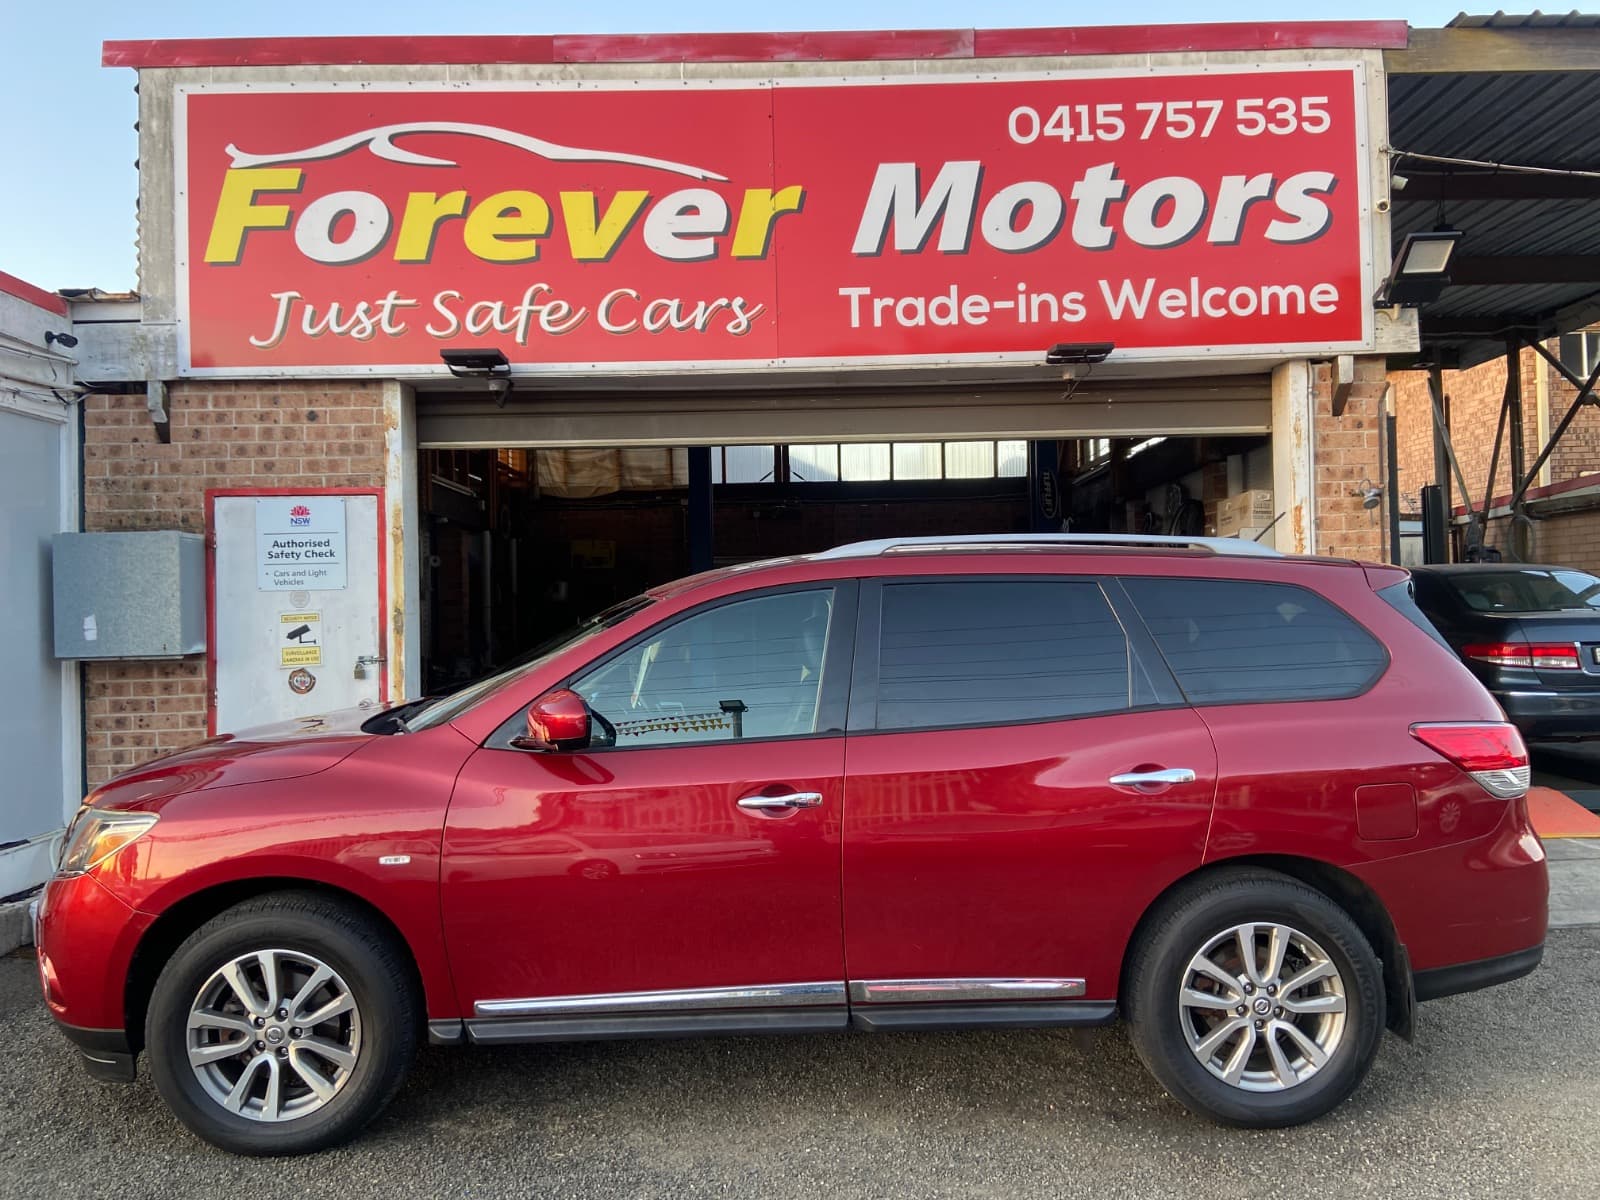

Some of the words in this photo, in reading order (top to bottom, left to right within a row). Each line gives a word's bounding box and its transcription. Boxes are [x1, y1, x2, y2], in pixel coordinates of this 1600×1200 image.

[1007, 103, 1126, 145] 0415
[1136, 99, 1224, 141] 757
[1236, 95, 1332, 137] 535
[203, 167, 805, 265] Forever
[850, 160, 1338, 257] Motors
[248, 290, 419, 351] Just
[424, 283, 589, 347] Safe
[597, 287, 767, 338] Cars
[838, 281, 1087, 328] Trade-ins
[1099, 276, 1339, 321] Welcome
[290, 517, 311, 525] NSW
[267, 550, 301, 561] Safety
[304, 549, 336, 559] Check
[272, 539, 331, 549] Authorised
[273, 570, 290, 578] Cars
[291, 569, 306, 577] and
[308, 569, 327, 579] Light
[273, 578, 304, 586] Vehicles
